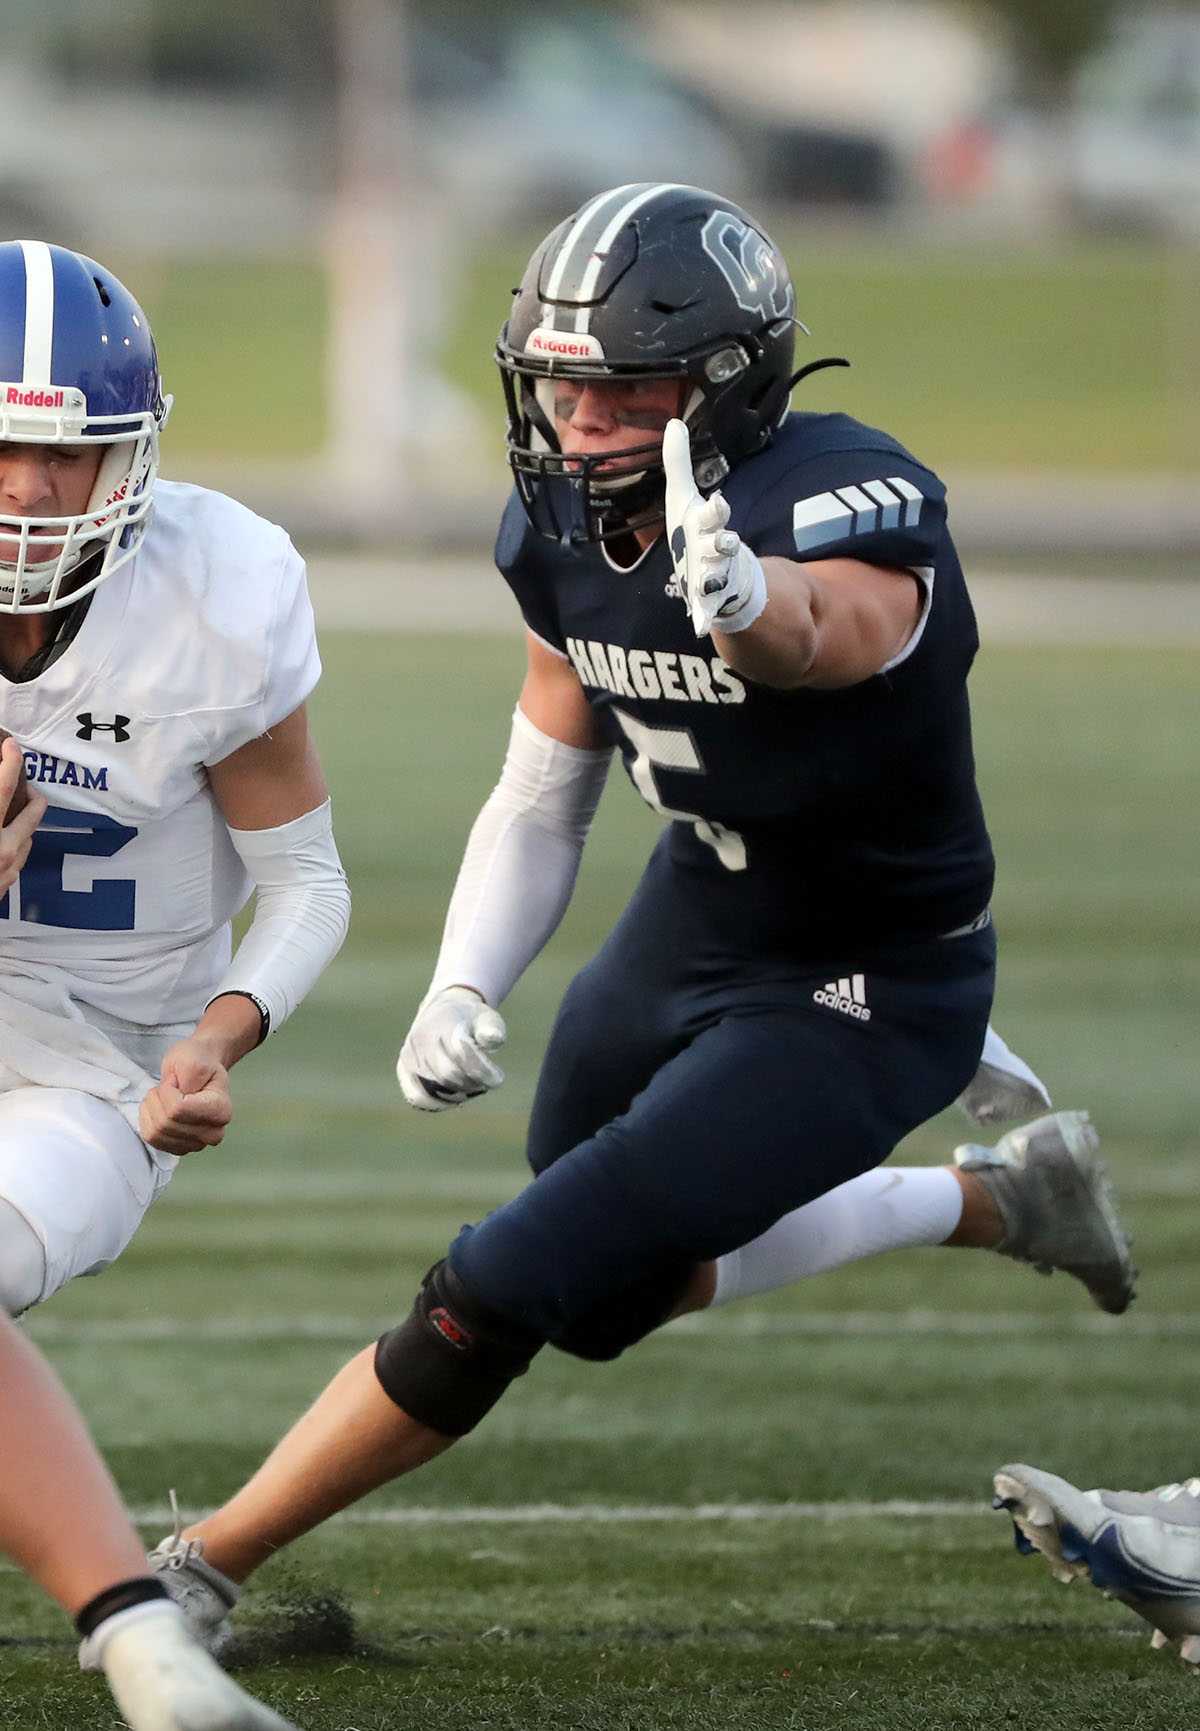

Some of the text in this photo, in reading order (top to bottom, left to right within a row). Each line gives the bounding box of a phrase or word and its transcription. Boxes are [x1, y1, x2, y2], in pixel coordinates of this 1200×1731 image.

[6, 387, 64, 408] Riddell
[566, 637, 747, 704] HARGERS
[22, 751, 109, 791] GHAM
[813, 989, 872, 1021] adidas
